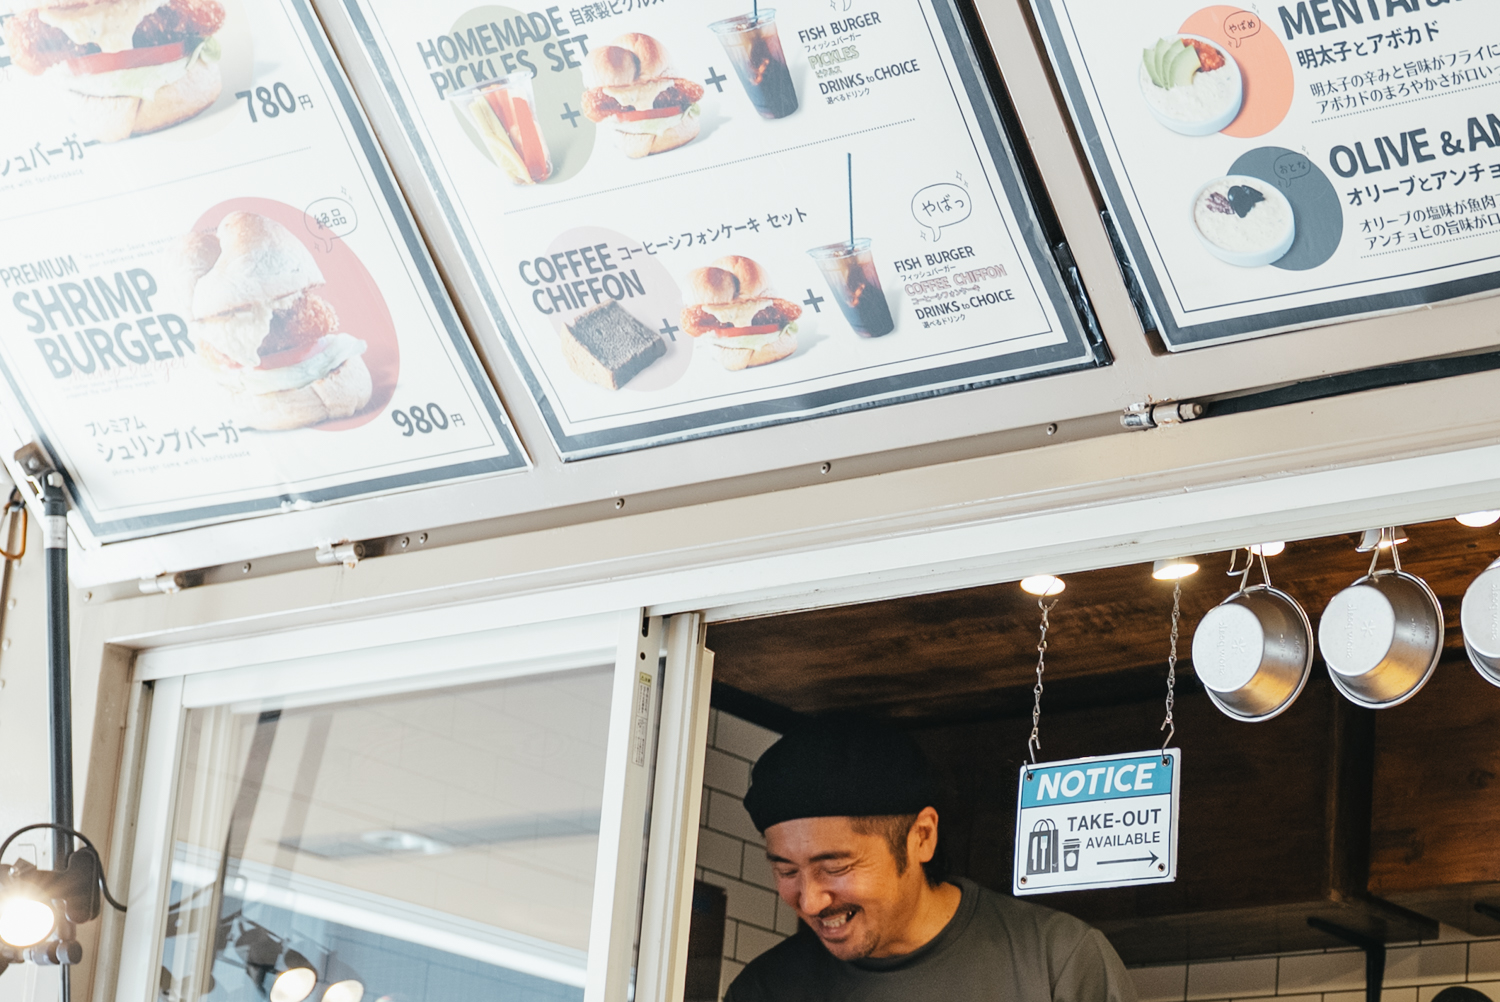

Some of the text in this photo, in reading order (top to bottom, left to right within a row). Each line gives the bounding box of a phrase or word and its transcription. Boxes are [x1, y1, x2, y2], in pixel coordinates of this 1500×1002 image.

[417, 6, 570, 70] HOMEMADE
[798, 11, 882, 44] FISH BURGER
[804, 33, 862, 53] フィッシュバーガー
[1296, 20, 1440, 70] 明太子とアボカド
[547, 34, 589, 72] SET
[807, 44, 860, 70] PICKLES
[818, 59, 920, 95] DRINKS to CHOICE
[1328, 127, 1436, 179] OLIVE
[1439, 130, 1466, 157] &
[617, 207, 808, 262] コーヒーシフォンケーキ セット
[0, 255, 80, 288] PREMIUM
[518, 243, 618, 287] COFFEE
[894, 245, 976, 273] FISH BURGER
[532, 269, 646, 315] CHIFFON
[905, 263, 1008, 297] COFFEE CHIFFON
[13, 267, 158, 334] SHRIMP
[915, 289, 1015, 320] DRINKS to CHOICE
[34, 313, 197, 379] BURGER
[84, 415, 147, 436] プレミアム
[97, 419, 257, 462] シュリンプバーガー
[1036, 762, 1157, 801] NOTICE
[1067, 808, 1162, 832] TAKE-OUT
[1085, 831, 1161, 849] AVAILABLE
